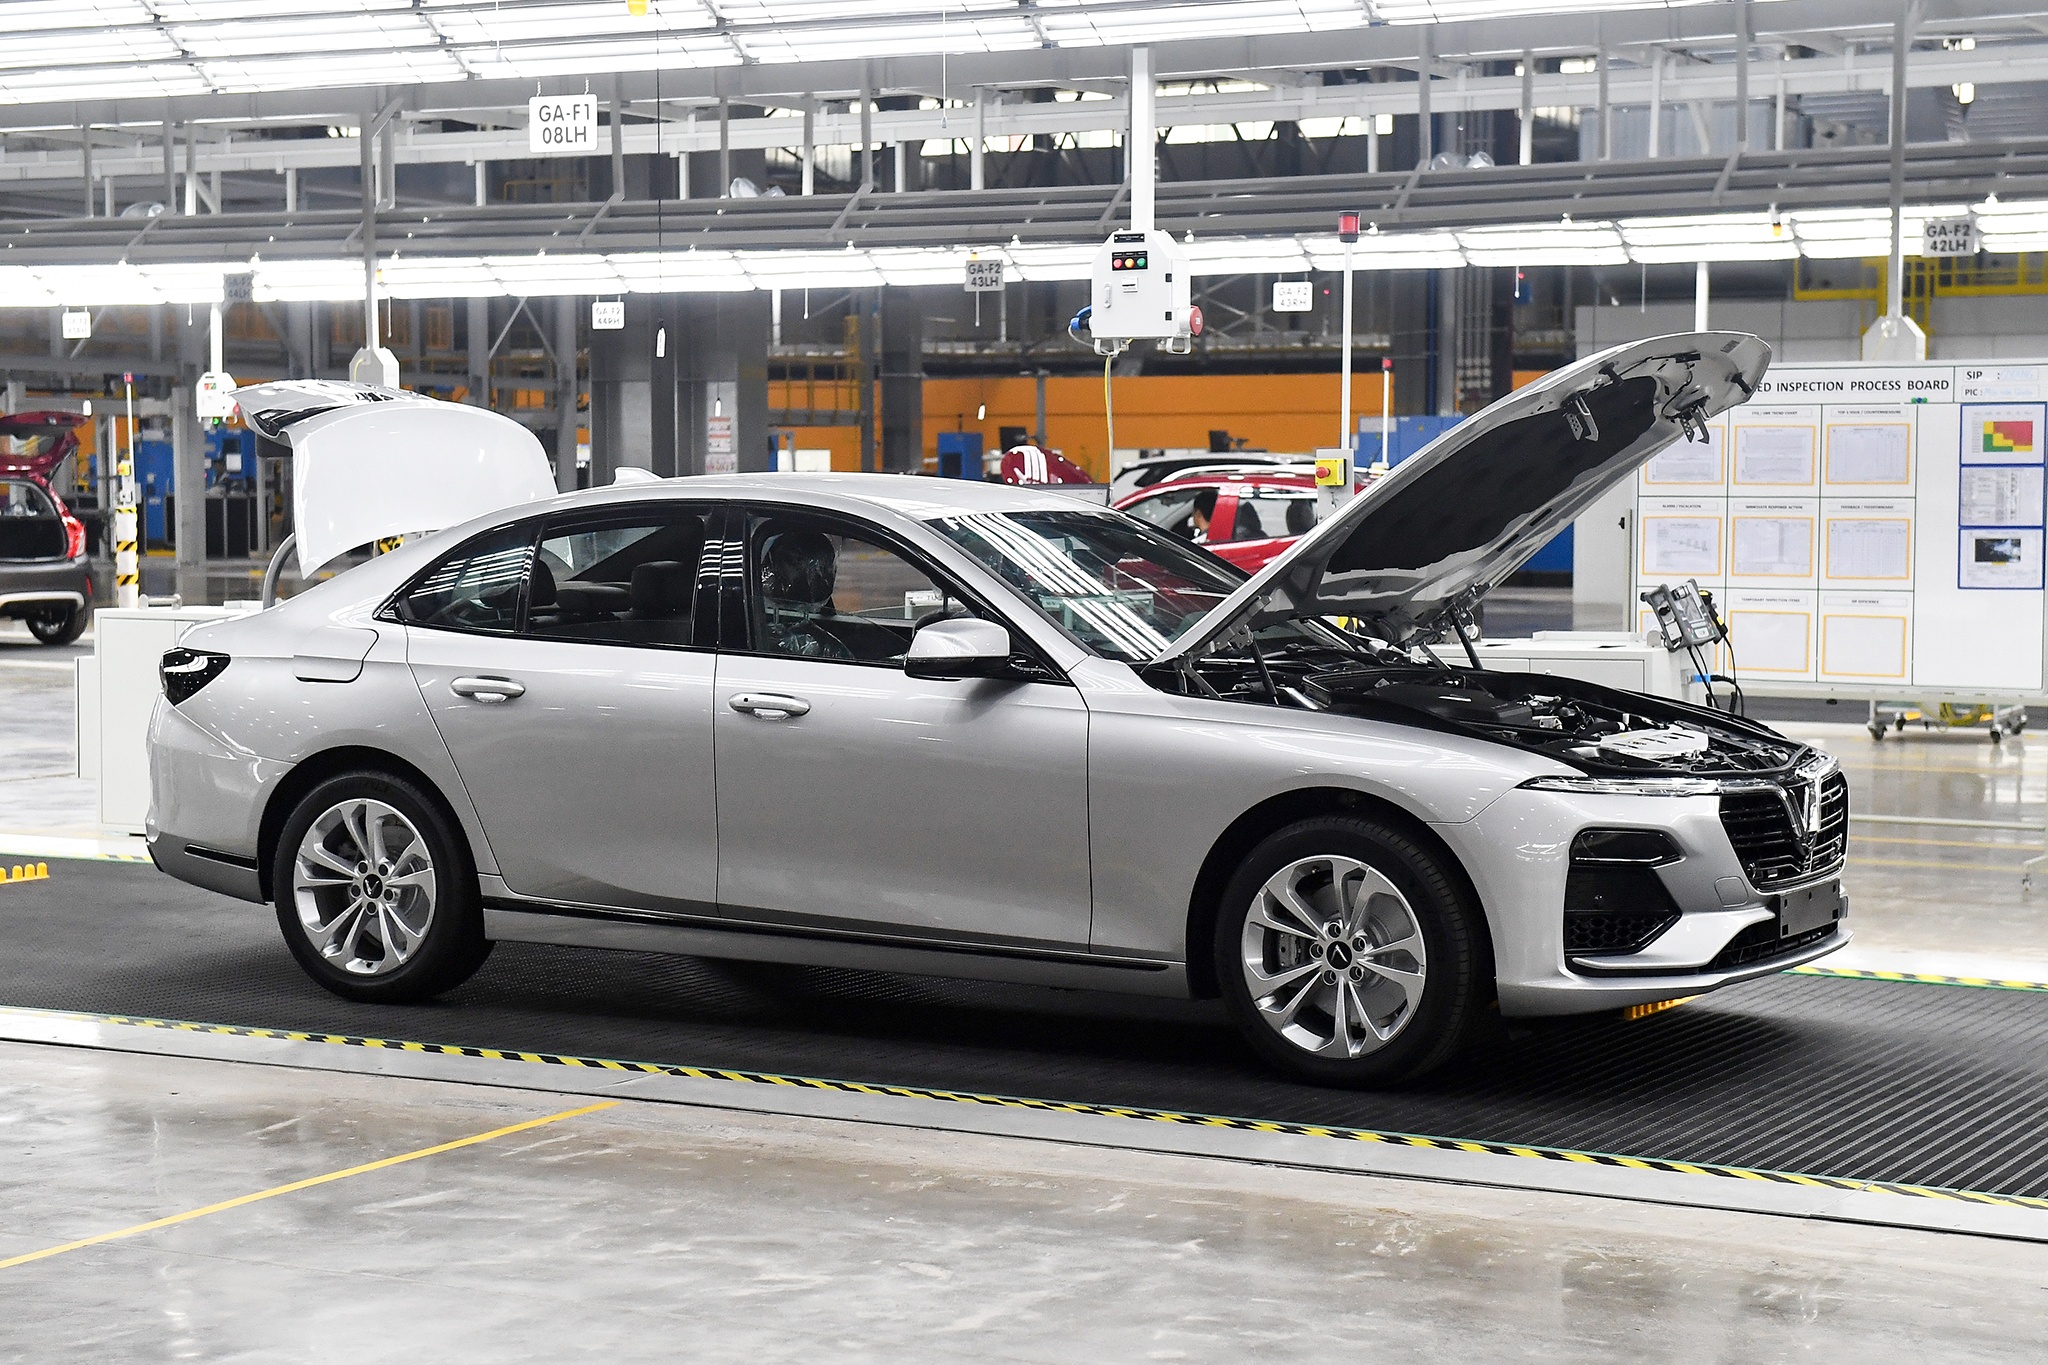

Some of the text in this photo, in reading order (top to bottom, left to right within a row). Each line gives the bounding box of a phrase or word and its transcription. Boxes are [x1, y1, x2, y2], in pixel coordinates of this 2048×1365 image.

[538, 104, 590, 122] GA-F1
[542, 126, 587, 144] 08LH
[1926, 224, 1970, 238] GA-F2
[1930, 239, 1967, 252] 42LH
[968, 263, 1001, 275] GA-F2
[970, 276, 999, 287] 43LH
[596, 307, 621, 315] GAF2
[1966, 370, 1983, 380] SIP
[1757, 379, 1950, 392] ED INSPECTION PROCESS BOARD
[1964, 388, 1978, 396] PIC
